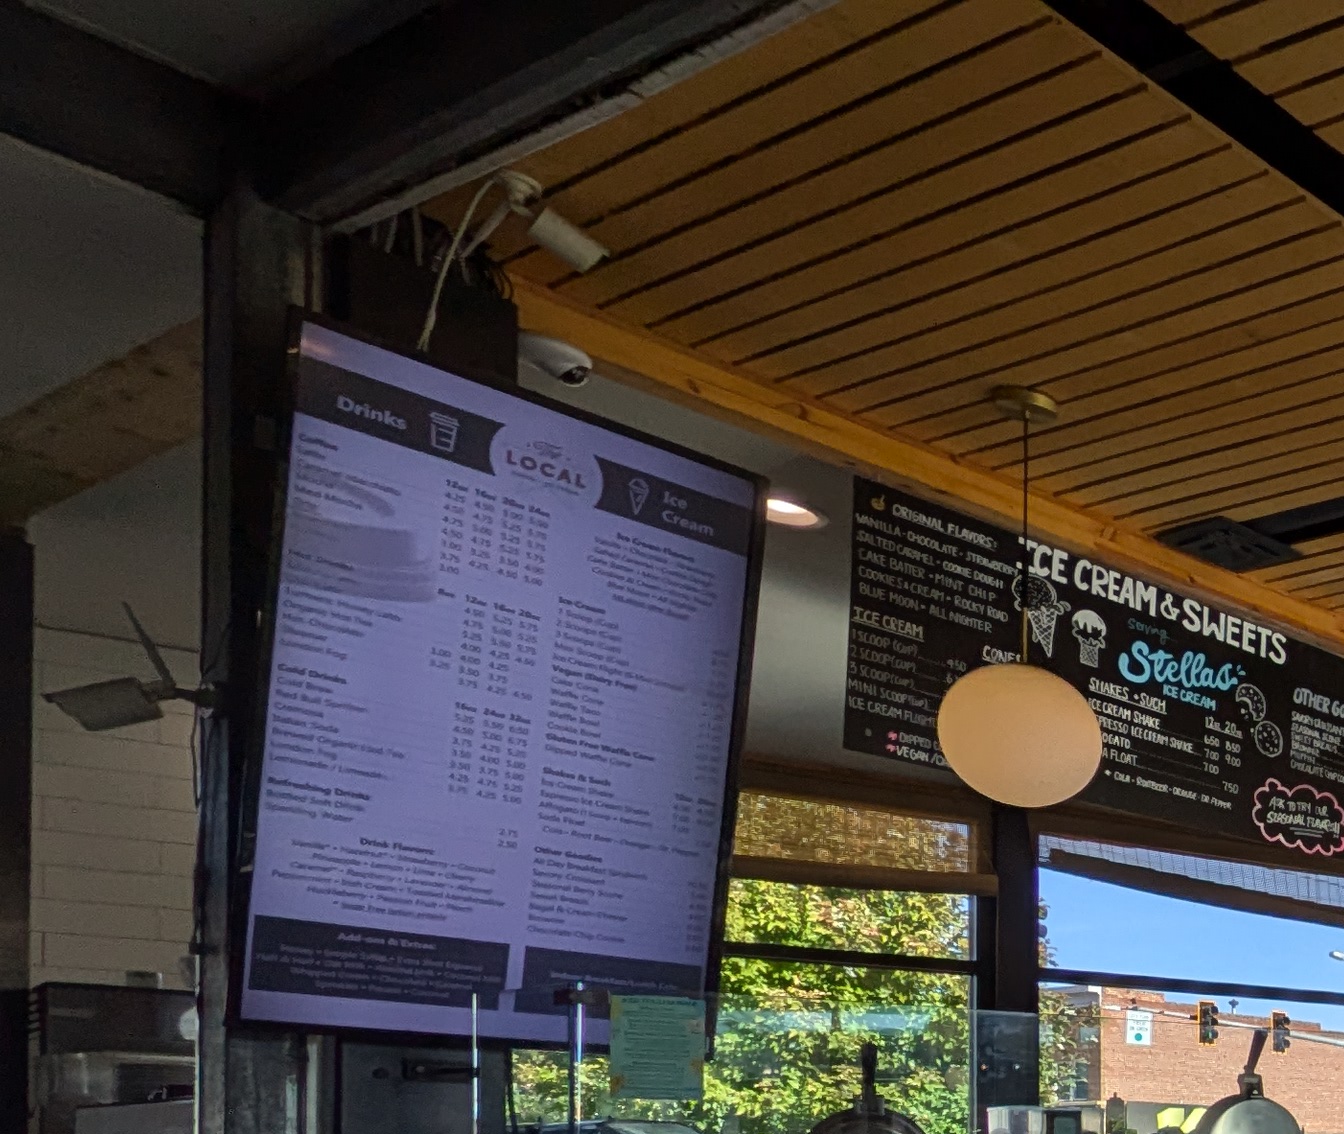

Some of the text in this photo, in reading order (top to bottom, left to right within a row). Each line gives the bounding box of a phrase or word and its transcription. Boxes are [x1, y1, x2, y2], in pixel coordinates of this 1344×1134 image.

[336, 396, 407, 430] Drinks
[505, 449, 586, 489] LOCAL
[663, 491, 688, 510] Ice
[662, 510, 714, 537] Cream
[892, 504, 944, 531] ORIGINAL
[856, 513, 1019, 576] VANILLA CHOCOLATE STRAWBERRY
[856, 530, 1004, 589] SALTED CARAMEL COOKIE DOUGH
[858, 548, 996, 601] CAKE BATTER MINT CHIP
[858, 565, 1009, 623] COOKIES CREAM ROCKY ROAD
[859, 582, 993, 634] BLUE MOON ALL NIGHTER
[1074, 559, 1158, 618] CREAM
[1160, 593, 1180, 621] &
[1182, 599, 1288, 666] SWEETS
[853, 606, 923, 639] ICE CREAM
[857, 630, 890, 649] SCOOP
[850, 645, 857, 657] 2
[859, 647, 890, 664] SCOOP
[850, 661, 857, 674] 3
[859, 665, 891, 683] SCOOP
[848, 678, 877, 697] MINI
[880, 688, 907, 704] SCOOP
[1089, 677, 1167, 711] SHAKES SUCH
[1163, 684, 1217, 712] ICE CREAM
[1293, 687, 1330, 714] OTHER
[848, 695, 865, 710] ICE
[867, 704, 902, 720] CREAM
[1102, 703, 1131, 722] CREAM
[1133, 711, 1160, 730] SHAKE
[899, 732, 931, 749] DIPPED
[1098, 716, 1129, 734] PRESSO
[1131, 726, 1143, 738] ICE
[1143, 730, 1169, 746] CREAM
[1169, 737, 1194, 754] SHAKE
[1102, 733, 1131, 750] OGATO
[896, 745, 929, 762] VEGAN
[1110, 749, 1138, 766] FLOAT
[1266, 811, 1305, 828] SEASONAL
[1297, 801, 1311, 814] TRY
